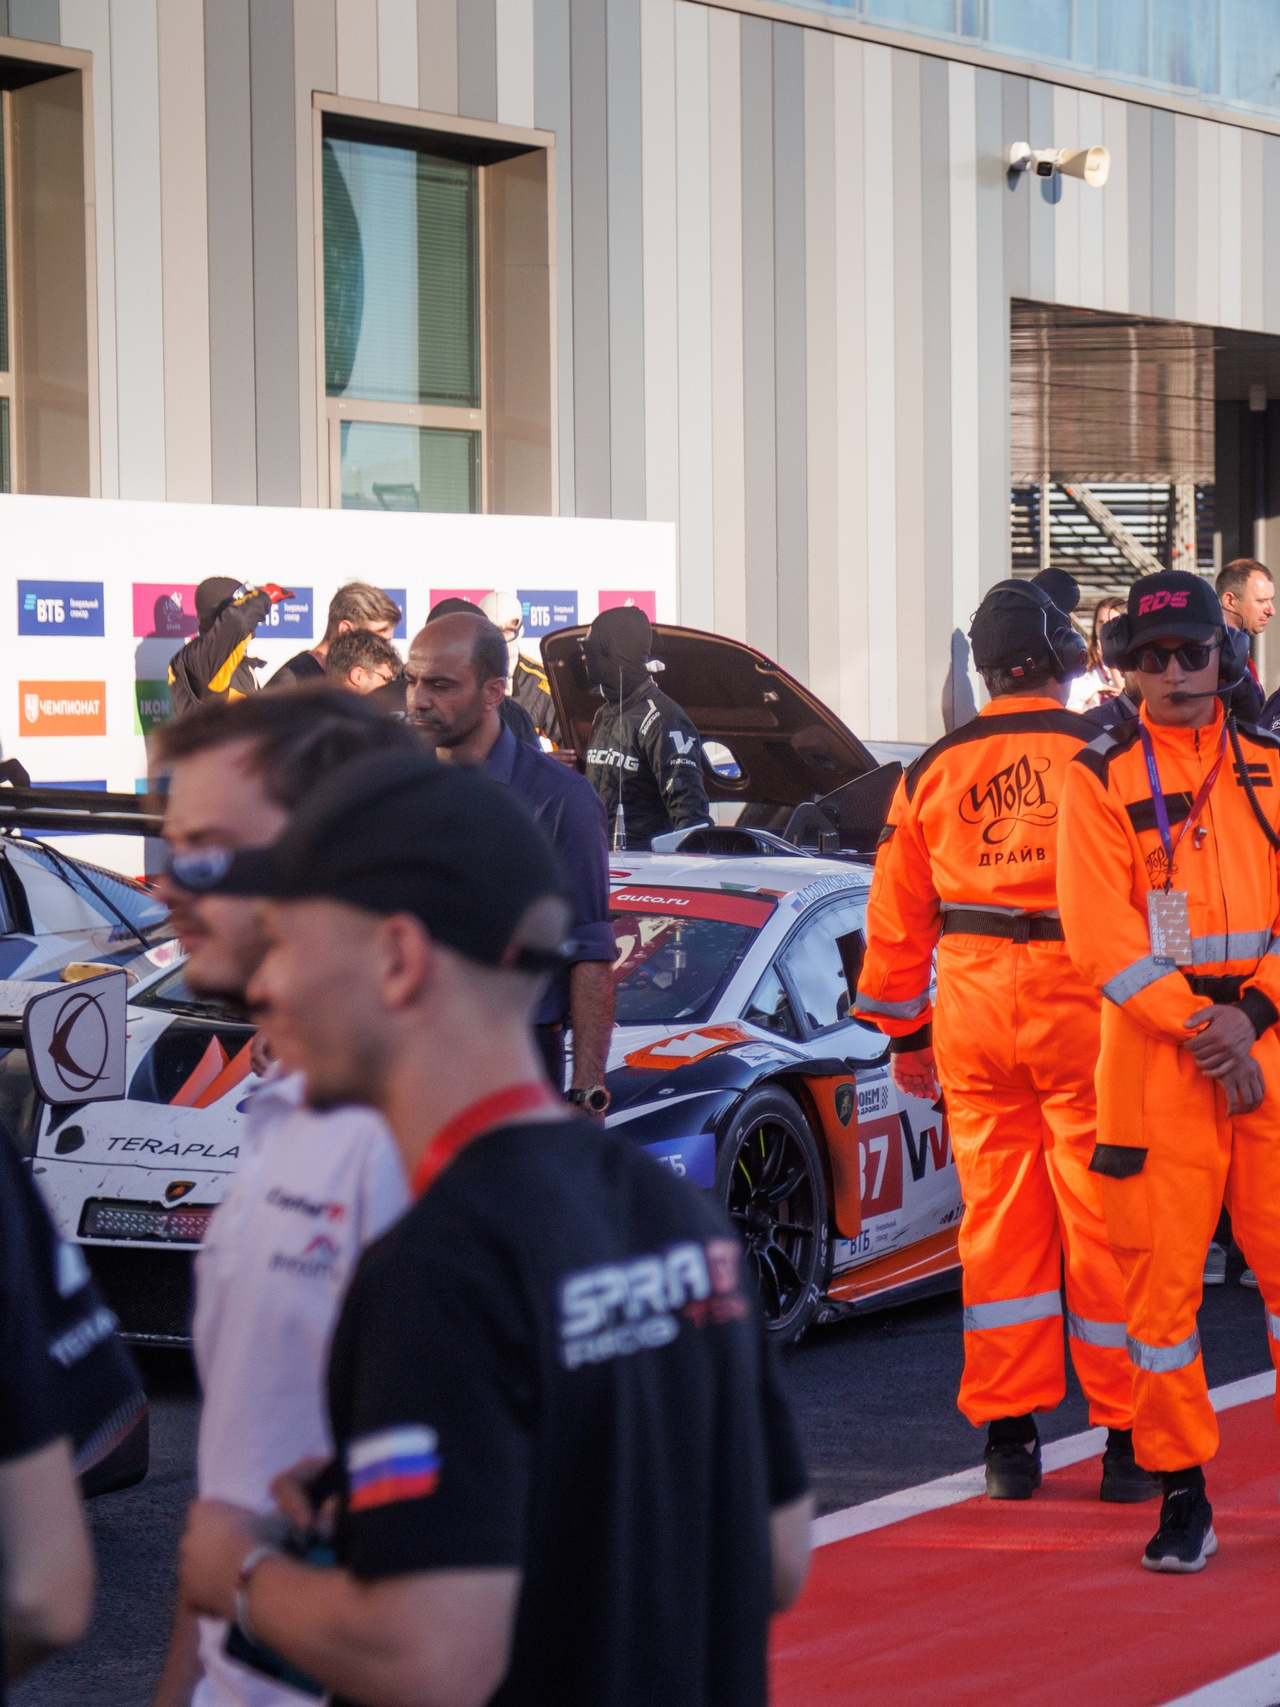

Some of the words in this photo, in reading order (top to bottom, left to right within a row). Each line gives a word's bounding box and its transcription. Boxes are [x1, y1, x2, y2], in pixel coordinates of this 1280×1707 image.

[37, 598, 66, 623] ВТБ
[530, 605, 550, 627] ВТБ
[40, 700, 100, 716] ЧЕМПИОНАТ
[140, 700, 170, 715] IKON
[978, 845, 1047, 867] ДРАЙВ
[616, 892, 690, 906] auto.ru
